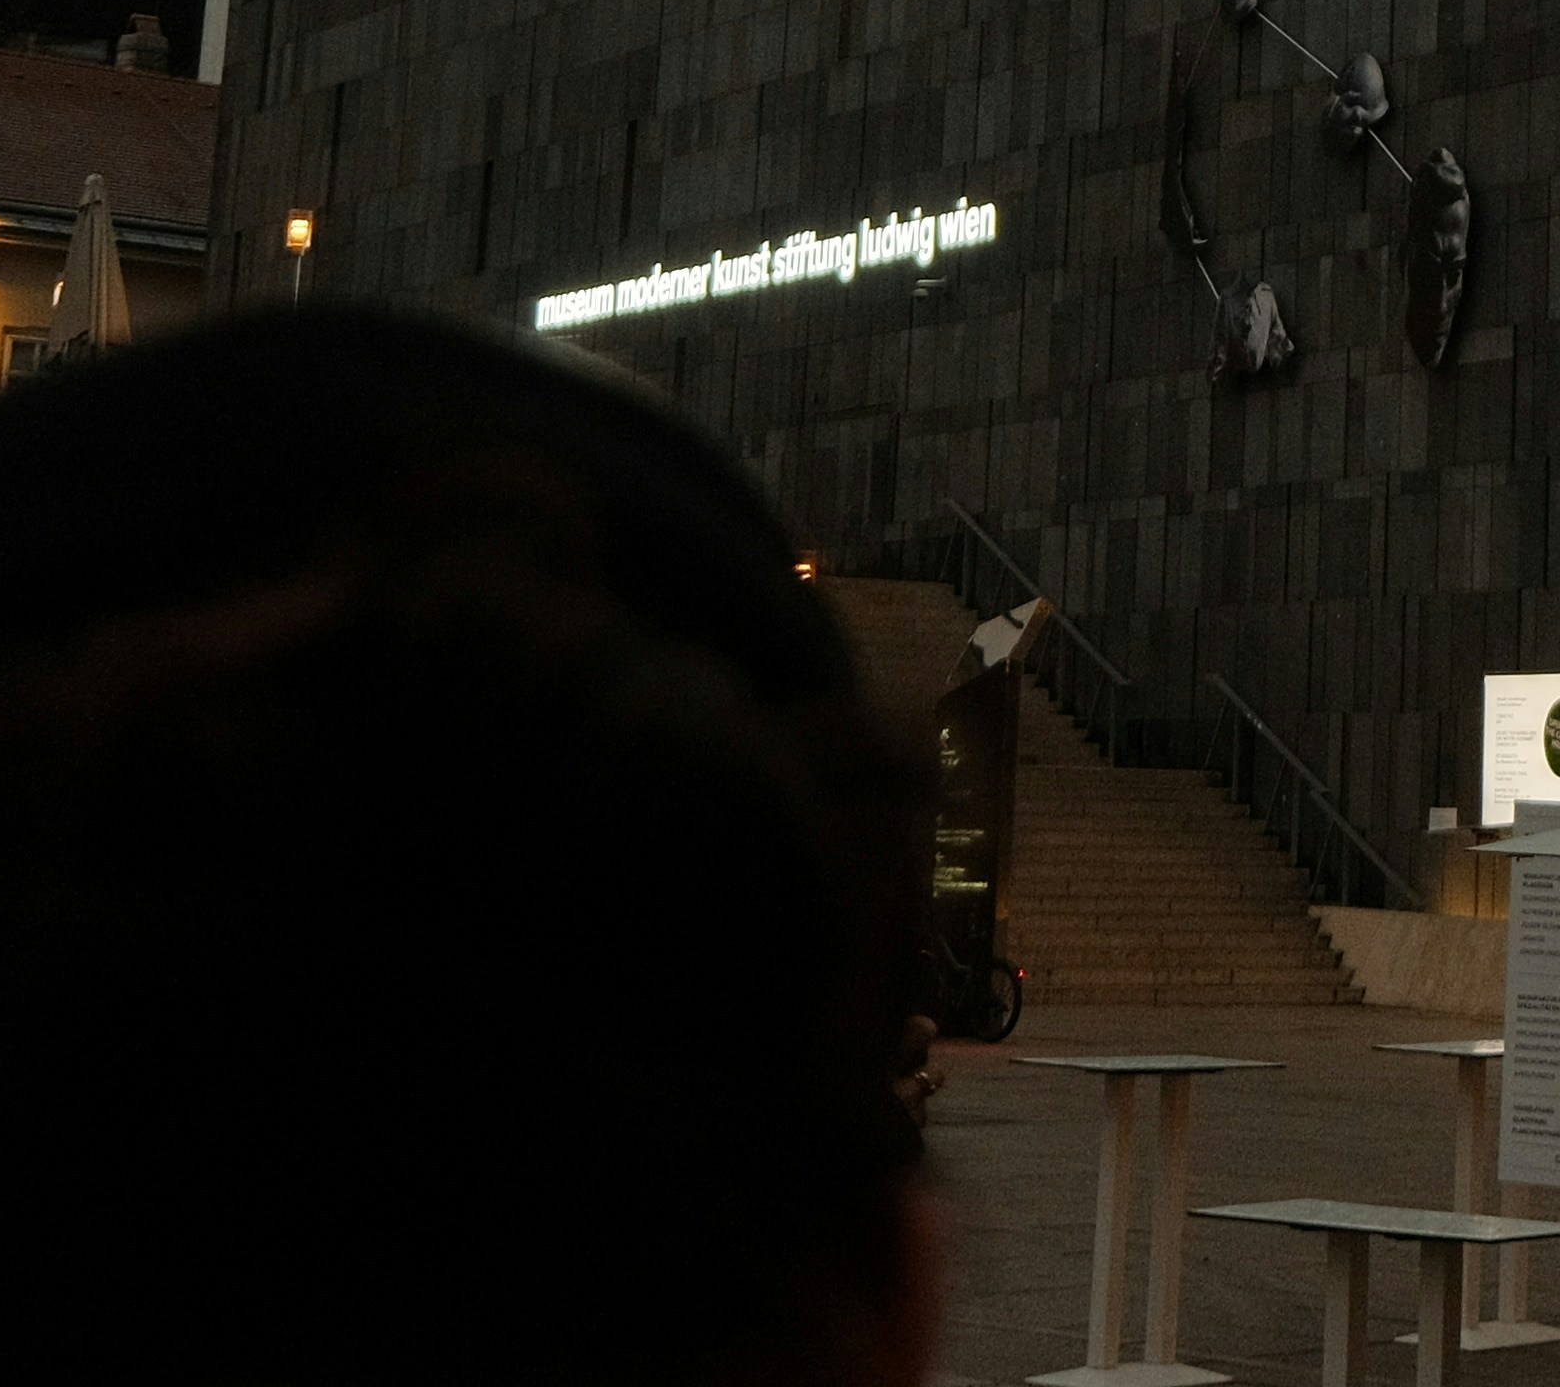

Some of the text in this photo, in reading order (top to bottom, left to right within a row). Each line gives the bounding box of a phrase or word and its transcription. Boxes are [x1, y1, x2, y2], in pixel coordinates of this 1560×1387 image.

[535, 195, 997, 331] museum moderner kunst stiftung ludwig wien
